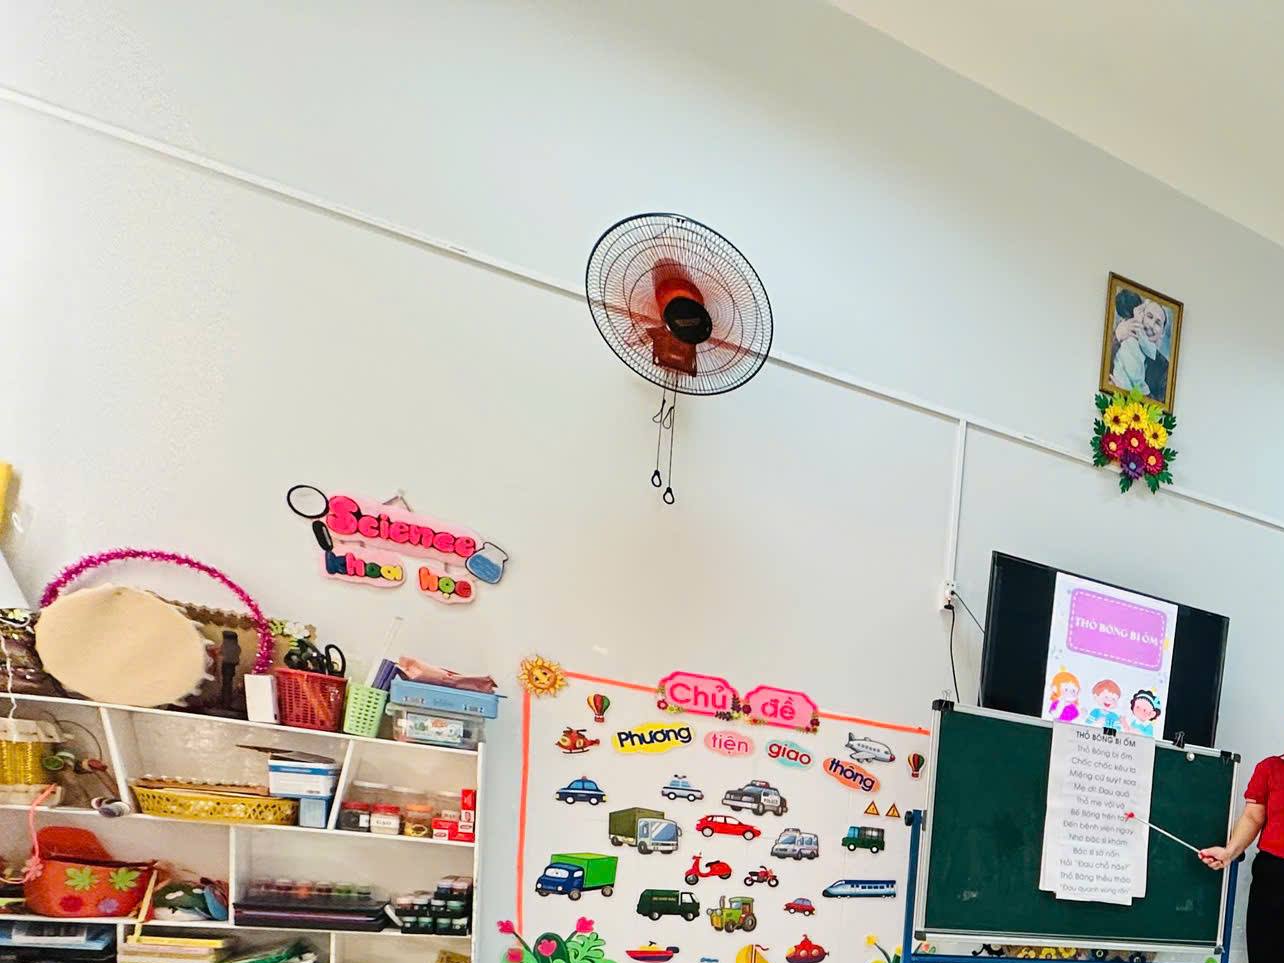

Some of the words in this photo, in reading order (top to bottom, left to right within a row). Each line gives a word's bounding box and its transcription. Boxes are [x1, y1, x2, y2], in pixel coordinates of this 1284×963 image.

[326, 495, 476, 557] Science
[1075, 616, 1098, 631] THỎ
[669, 682, 727, 711] Chủ
[761, 693, 797, 721] đề
[1077, 729, 1090, 740] THỎ
[1092, 734, 1113, 744] BÔNG
[617, 725, 692, 748] Phương
[711, 733, 749, 756] tiện
[767, 742, 811, 765] giao
[828, 757, 876, 792] thông
